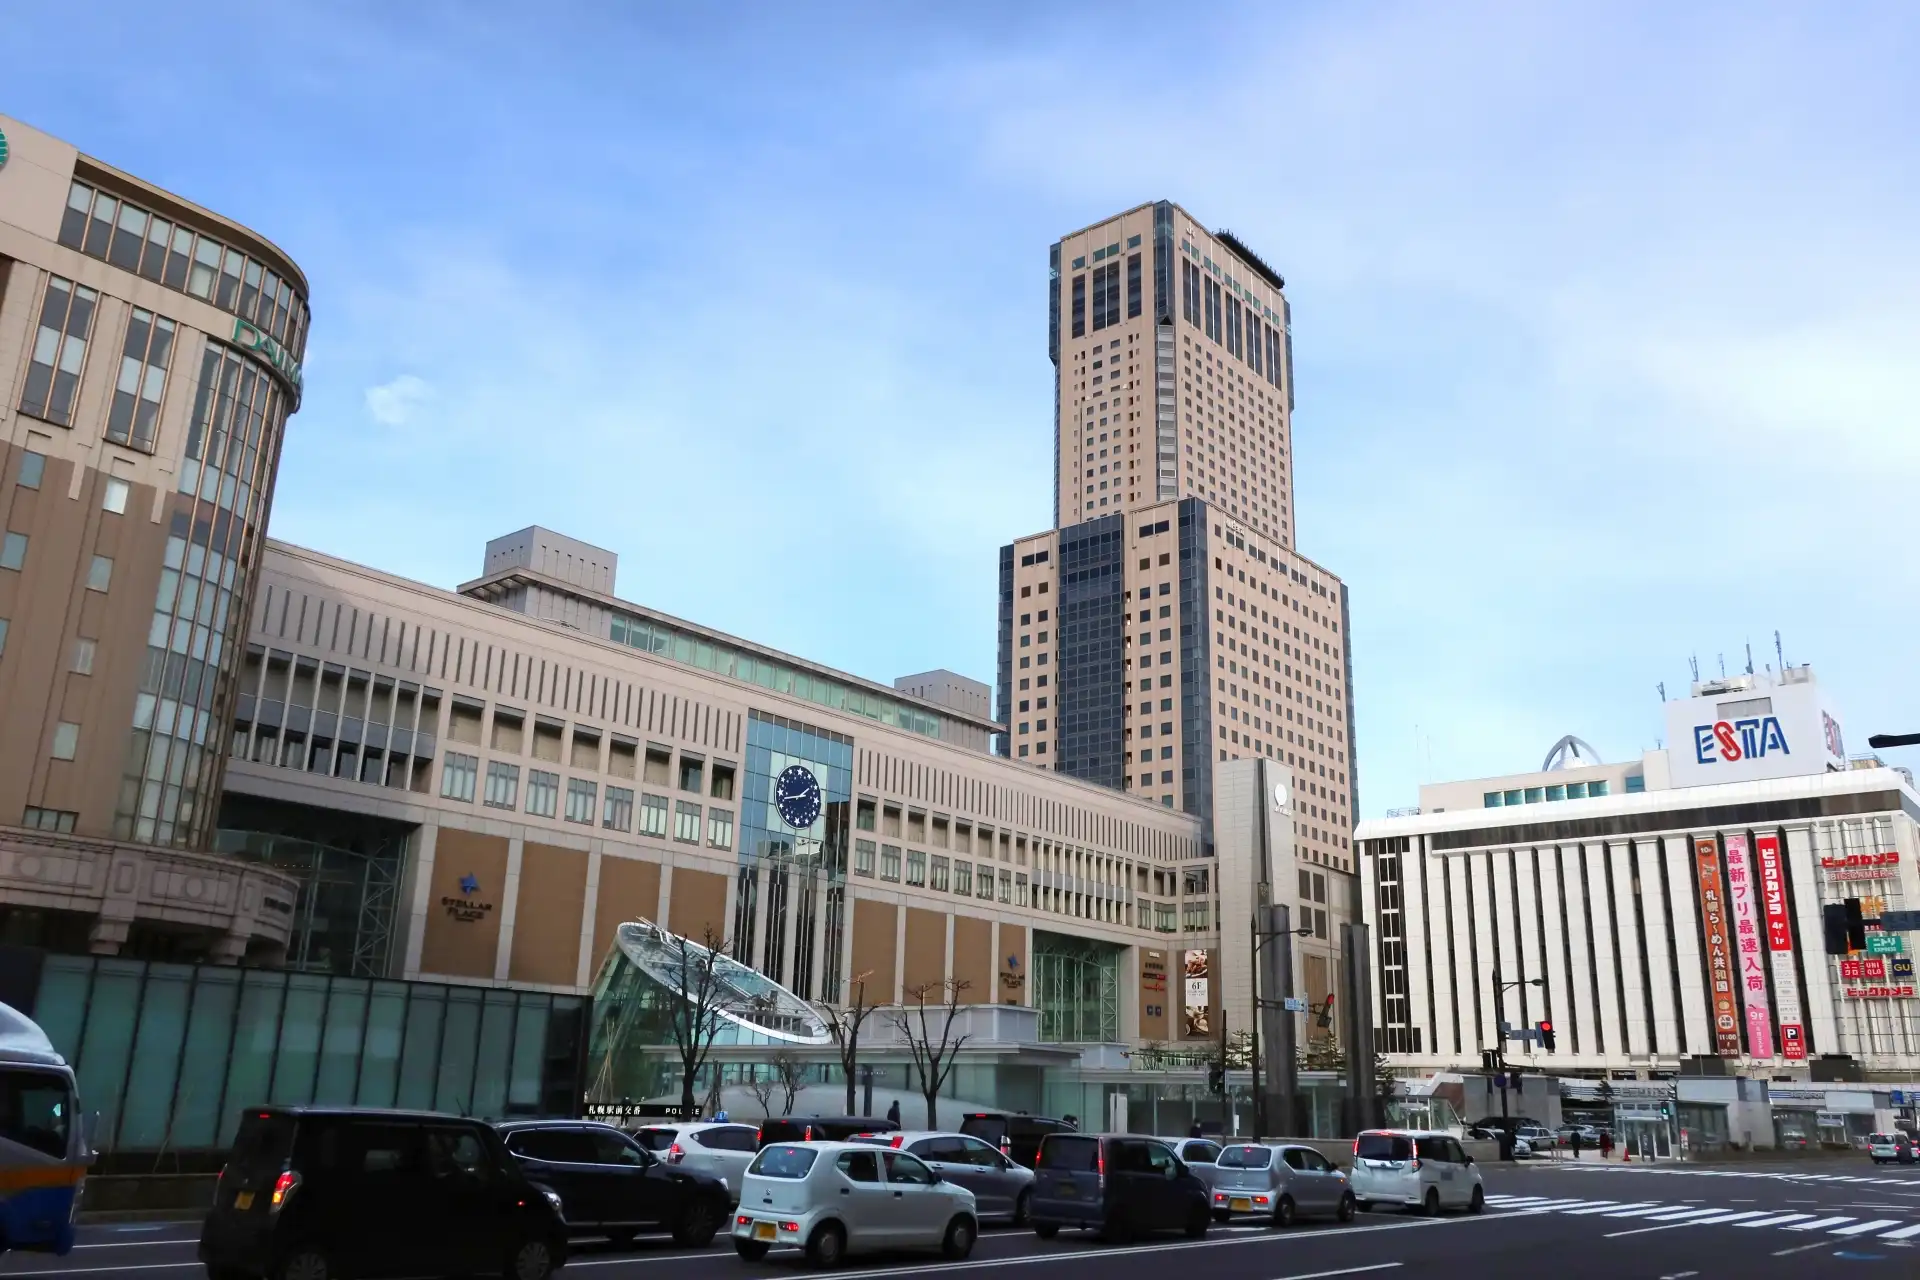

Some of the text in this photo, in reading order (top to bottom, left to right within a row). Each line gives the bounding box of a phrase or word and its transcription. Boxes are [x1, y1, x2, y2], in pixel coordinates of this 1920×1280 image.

[1694, 716, 1790, 765] ESTA
[1728, 850, 1762, 991] 最新プリ最速入荷
[1893, 963, 1911, 972] GU
[1191, 981, 1202, 991] 6F
[1786, 1028, 1797, 1039] P
[665, 1107, 700, 1115] POLE
